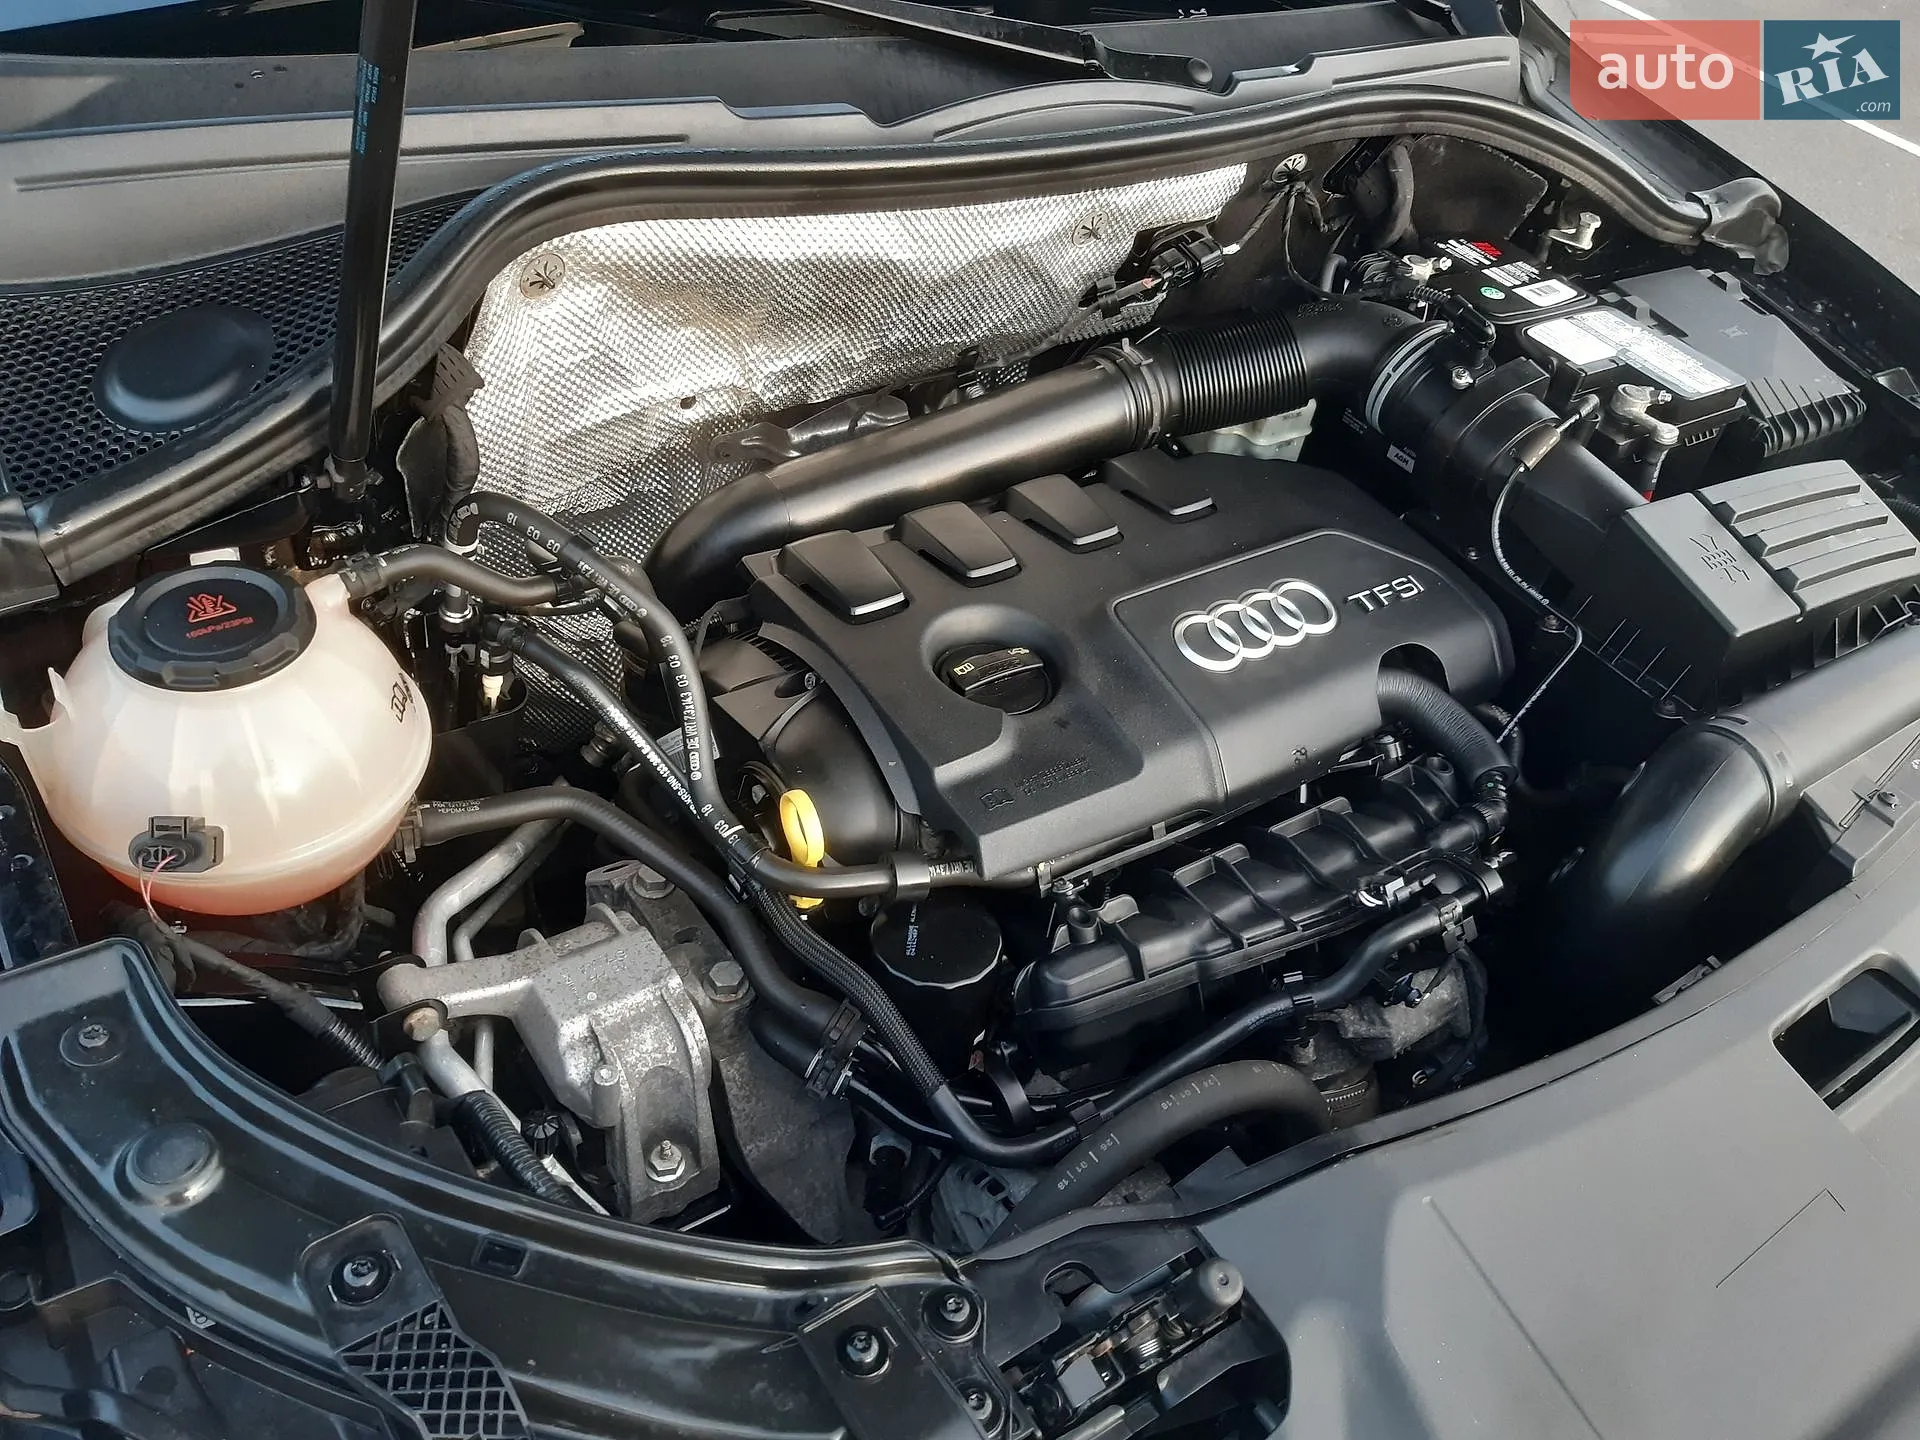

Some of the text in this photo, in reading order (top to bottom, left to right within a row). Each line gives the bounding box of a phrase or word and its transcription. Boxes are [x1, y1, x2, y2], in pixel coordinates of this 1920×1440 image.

[506, 512, 518, 526] 18
[526, 526, 541, 540] 03
[547, 539, 561, 553] 03
[1346, 574, 1425, 611] TFSI
[668, 655, 681, 668] 03
[675, 673, 689, 688] 03
[684, 718, 698, 738] VRT
[687, 737, 700, 750] DE
[701, 803, 714, 817] 18
[714, 819, 729, 835] 03
